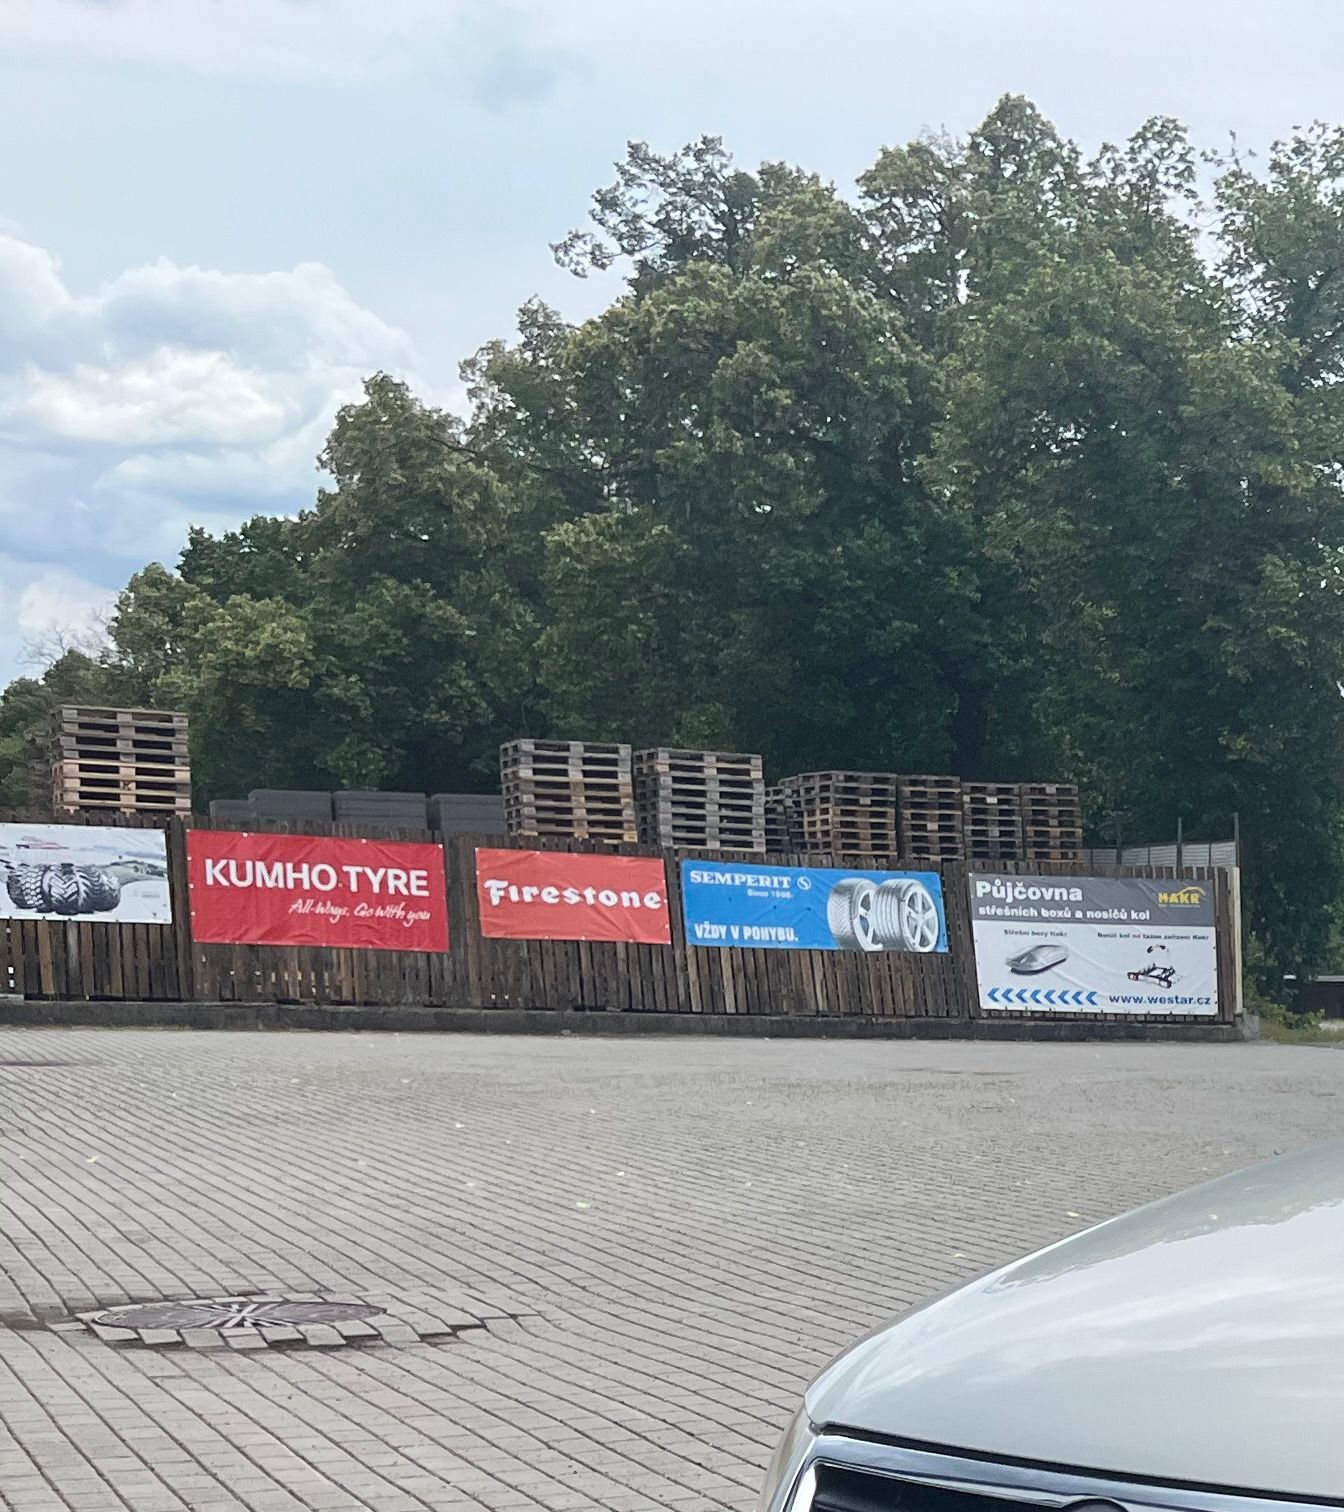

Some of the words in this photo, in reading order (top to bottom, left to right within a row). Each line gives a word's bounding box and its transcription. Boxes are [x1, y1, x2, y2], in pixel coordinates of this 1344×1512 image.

[205, 858, 338, 891] KUMHO
[342, 865, 430, 897] TYRE
[690, 870, 792, 889] SEMPERIT
[483, 879, 662, 910] Firestone
[975, 878, 1084, 904] Půjčovna
[1158, 892, 1201, 905] HAKR
[403, 909, 431, 927] you
[978, 905, 1038, 918] střešních
[1041, 906, 1072, 919] boxů
[1075, 910, 1083, 920] a
[1086, 908, 1128, 921] nosičů
[1131, 909, 1150, 921] kol
[694, 921, 727, 939] VŽDY
[730, 924, 740, 940] V
[743, 925, 799, 942] POHYBU.
[1109, 994, 1211, 1006] www.westar.cz
